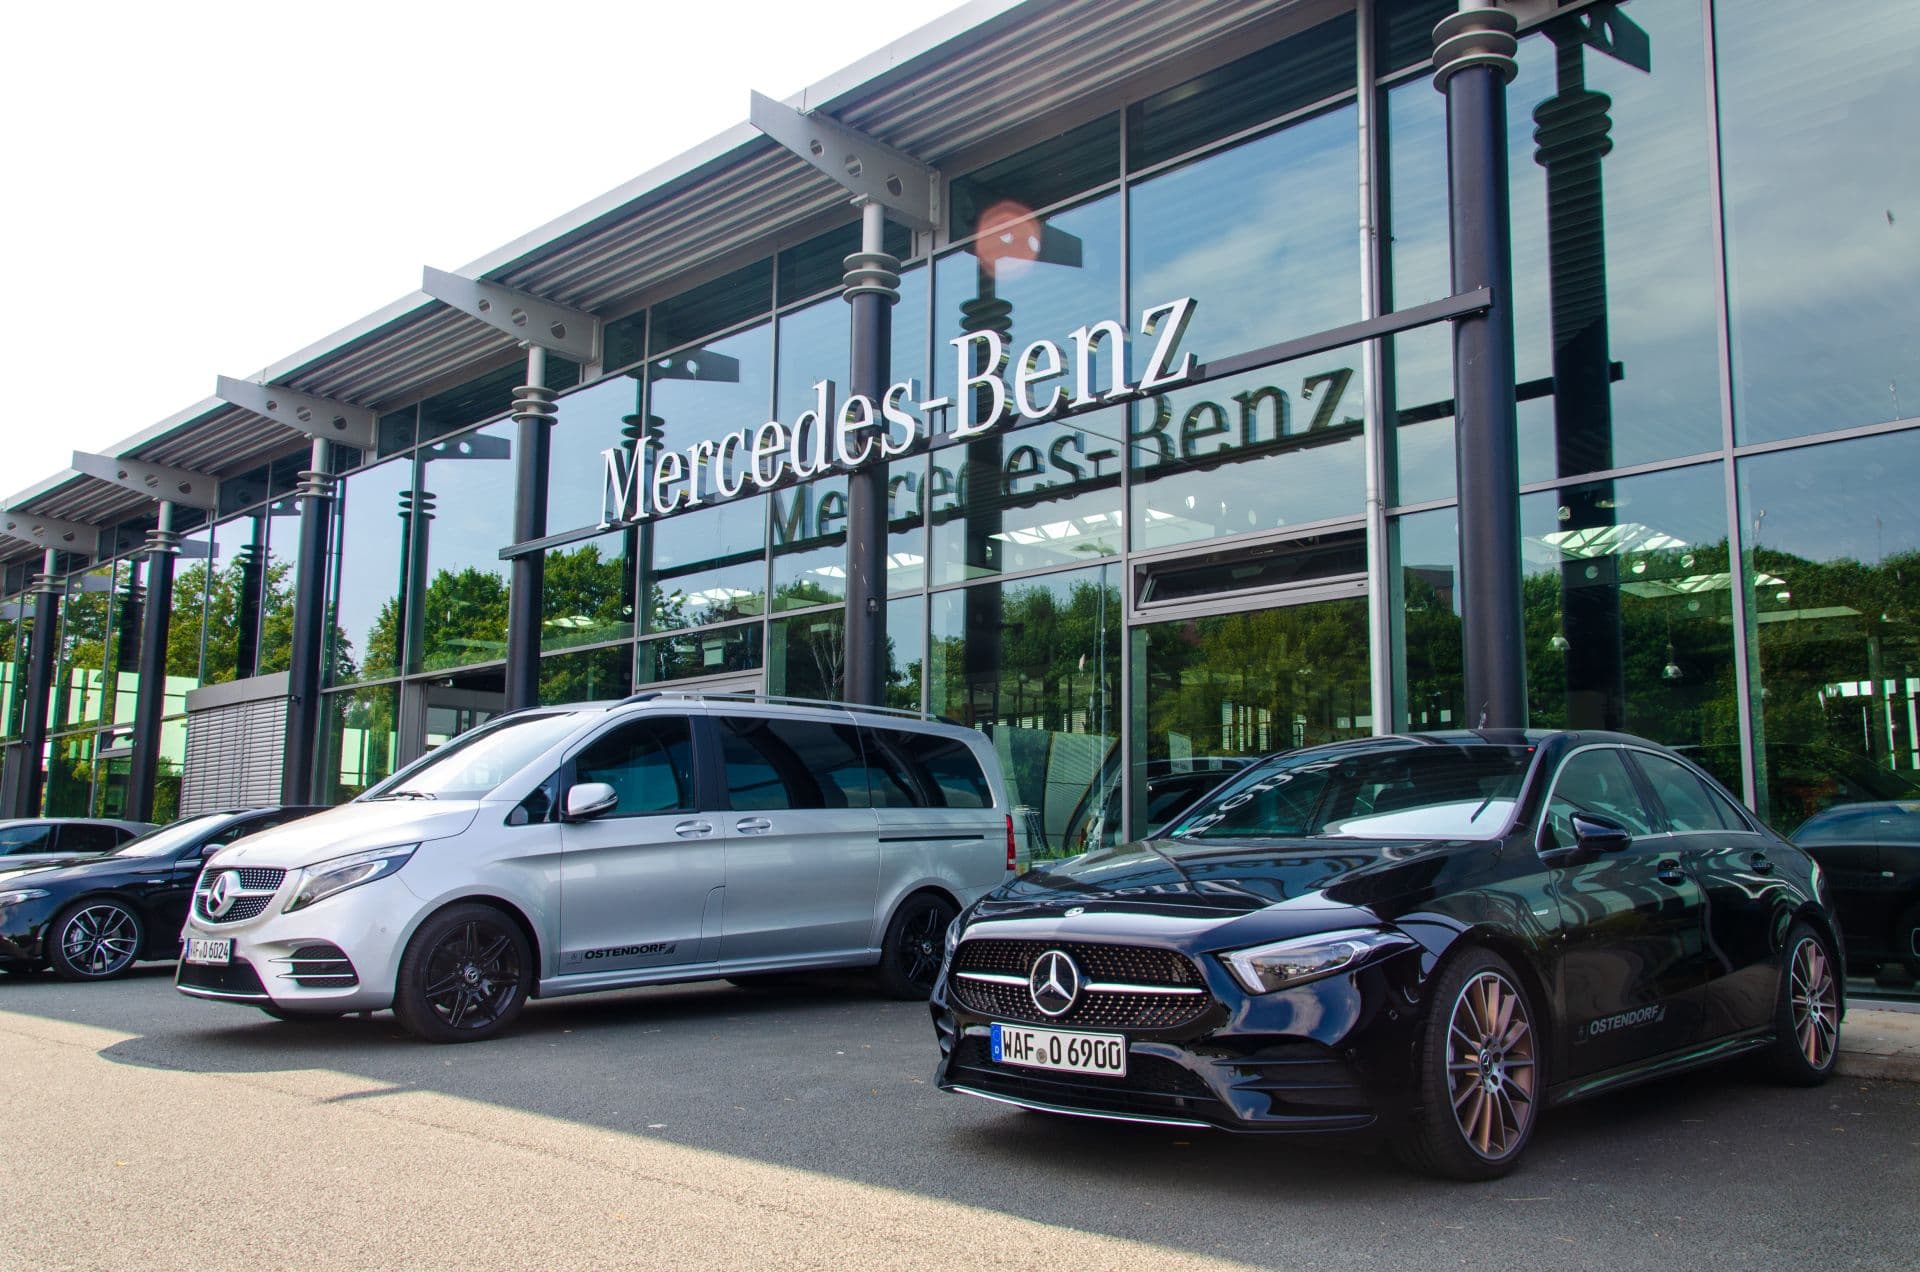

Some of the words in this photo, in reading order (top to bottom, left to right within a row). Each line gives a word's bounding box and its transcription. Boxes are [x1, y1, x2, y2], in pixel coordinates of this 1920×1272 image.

[596, 296, 1197, 530] Mercedes-Benz
[209, 941, 228, 960] 6024
[584, 943, 667, 960] OSTENDORF
[1589, 1004, 1660, 1035] OSTENDORF
[1002, 1030, 1034, 1061] WAF
[1067, 1037, 1121, 1070] 6900
